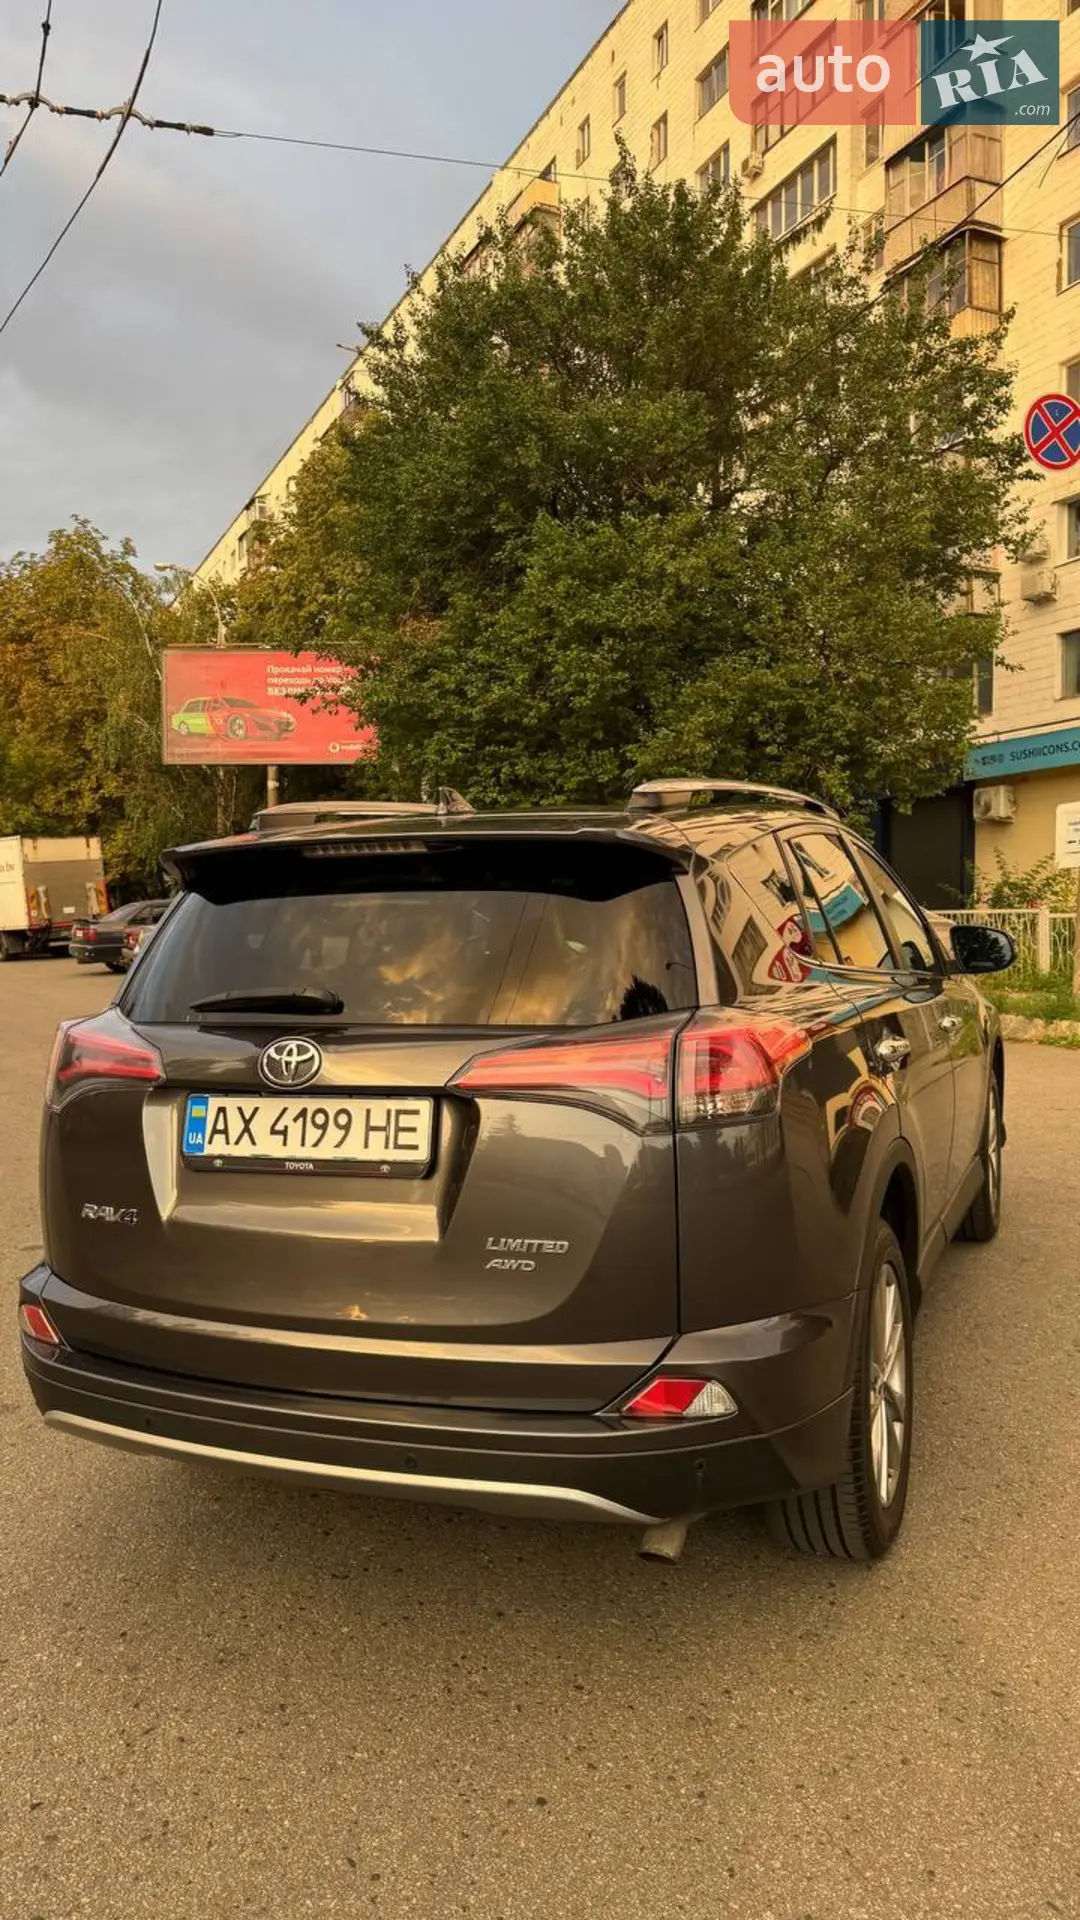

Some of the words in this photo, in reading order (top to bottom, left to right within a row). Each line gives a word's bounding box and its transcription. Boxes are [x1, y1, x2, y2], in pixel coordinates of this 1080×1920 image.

[1009, 740, 1080, 761] SUSHIICONS.C
[207, 1106, 260, 1146] AX
[269, 1106, 353, 1149] 4199
[364, 1108, 421, 1150] HE
[188, 1132, 203, 1145] UA
[285, 1161, 314, 1170] TOYOTA
[81, 1203, 137, 1224] RAV4
[485, 1237, 570, 1254] LIMITED
[484, 1258, 537, 1271] AWD
